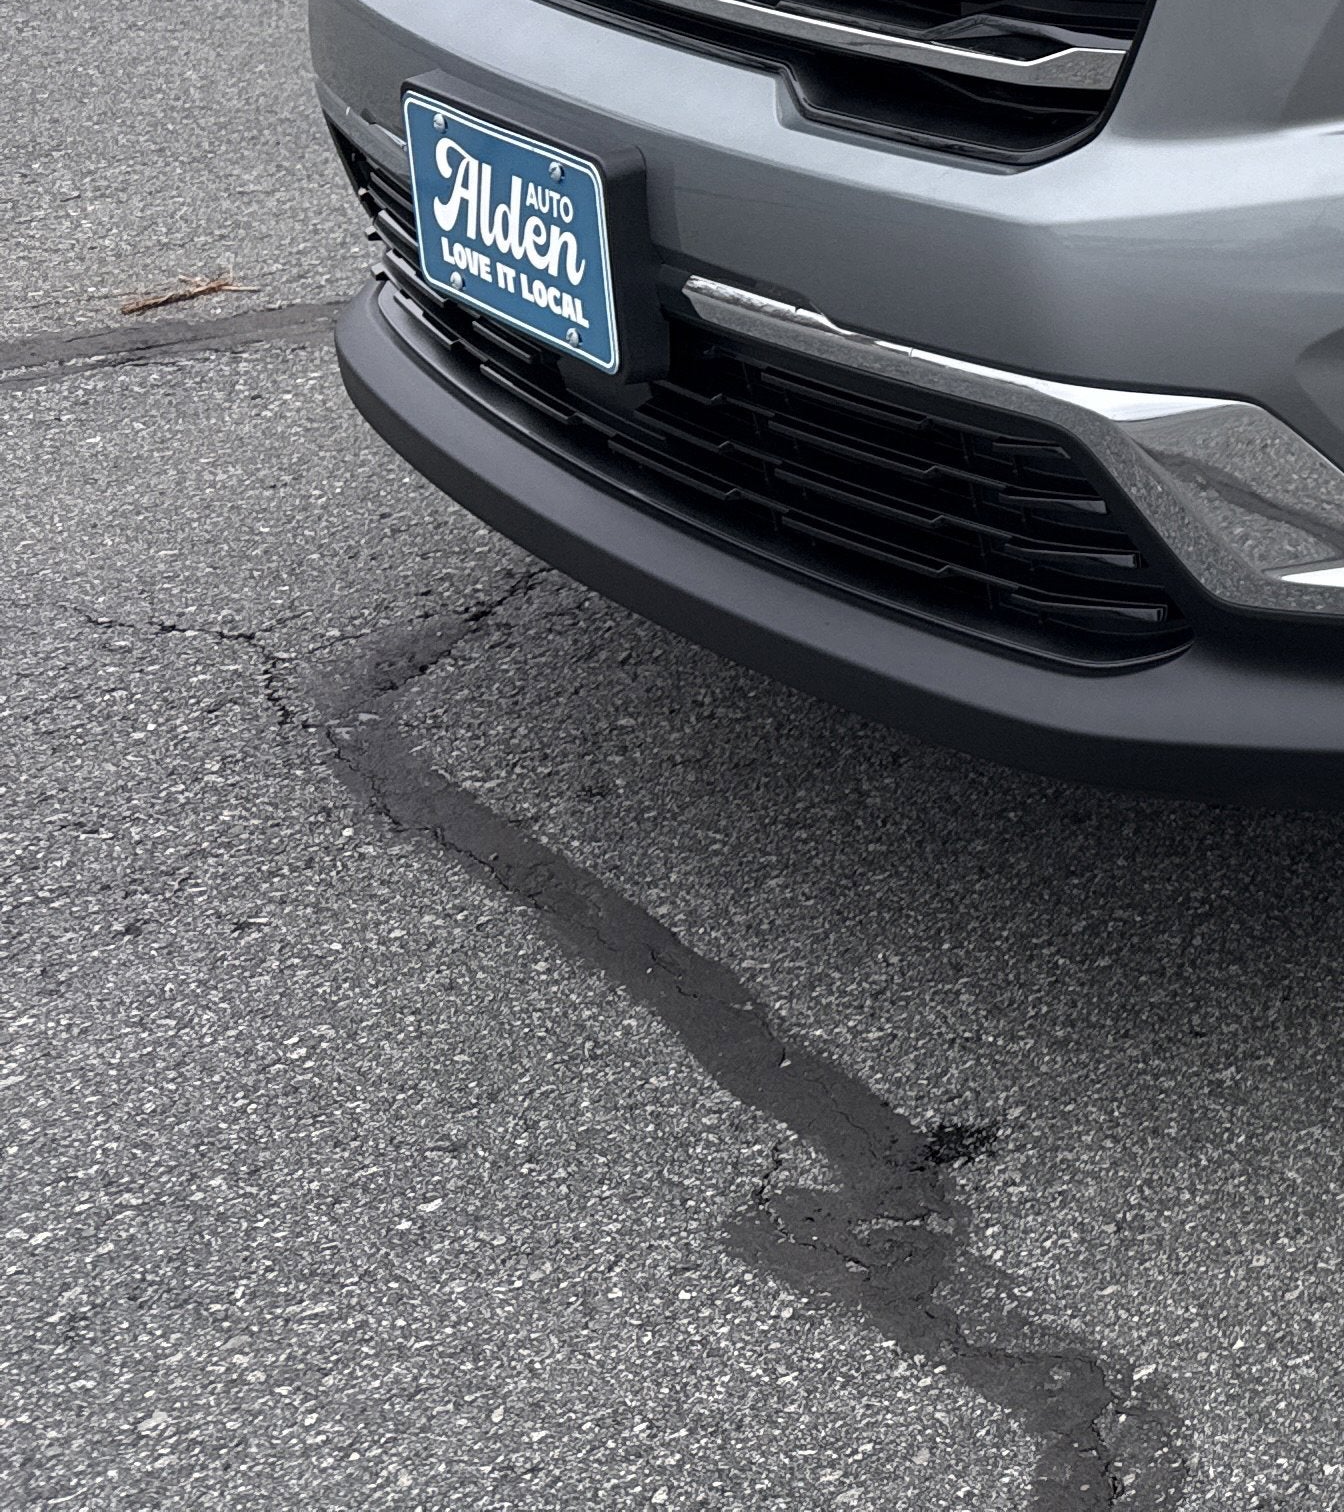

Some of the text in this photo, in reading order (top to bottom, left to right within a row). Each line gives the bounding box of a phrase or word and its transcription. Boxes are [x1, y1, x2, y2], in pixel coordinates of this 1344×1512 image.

[433, 137, 586, 286] Alden
[525, 182, 574, 223] AUTO
[441, 236, 590, 329] LOVE IT LOCAL
